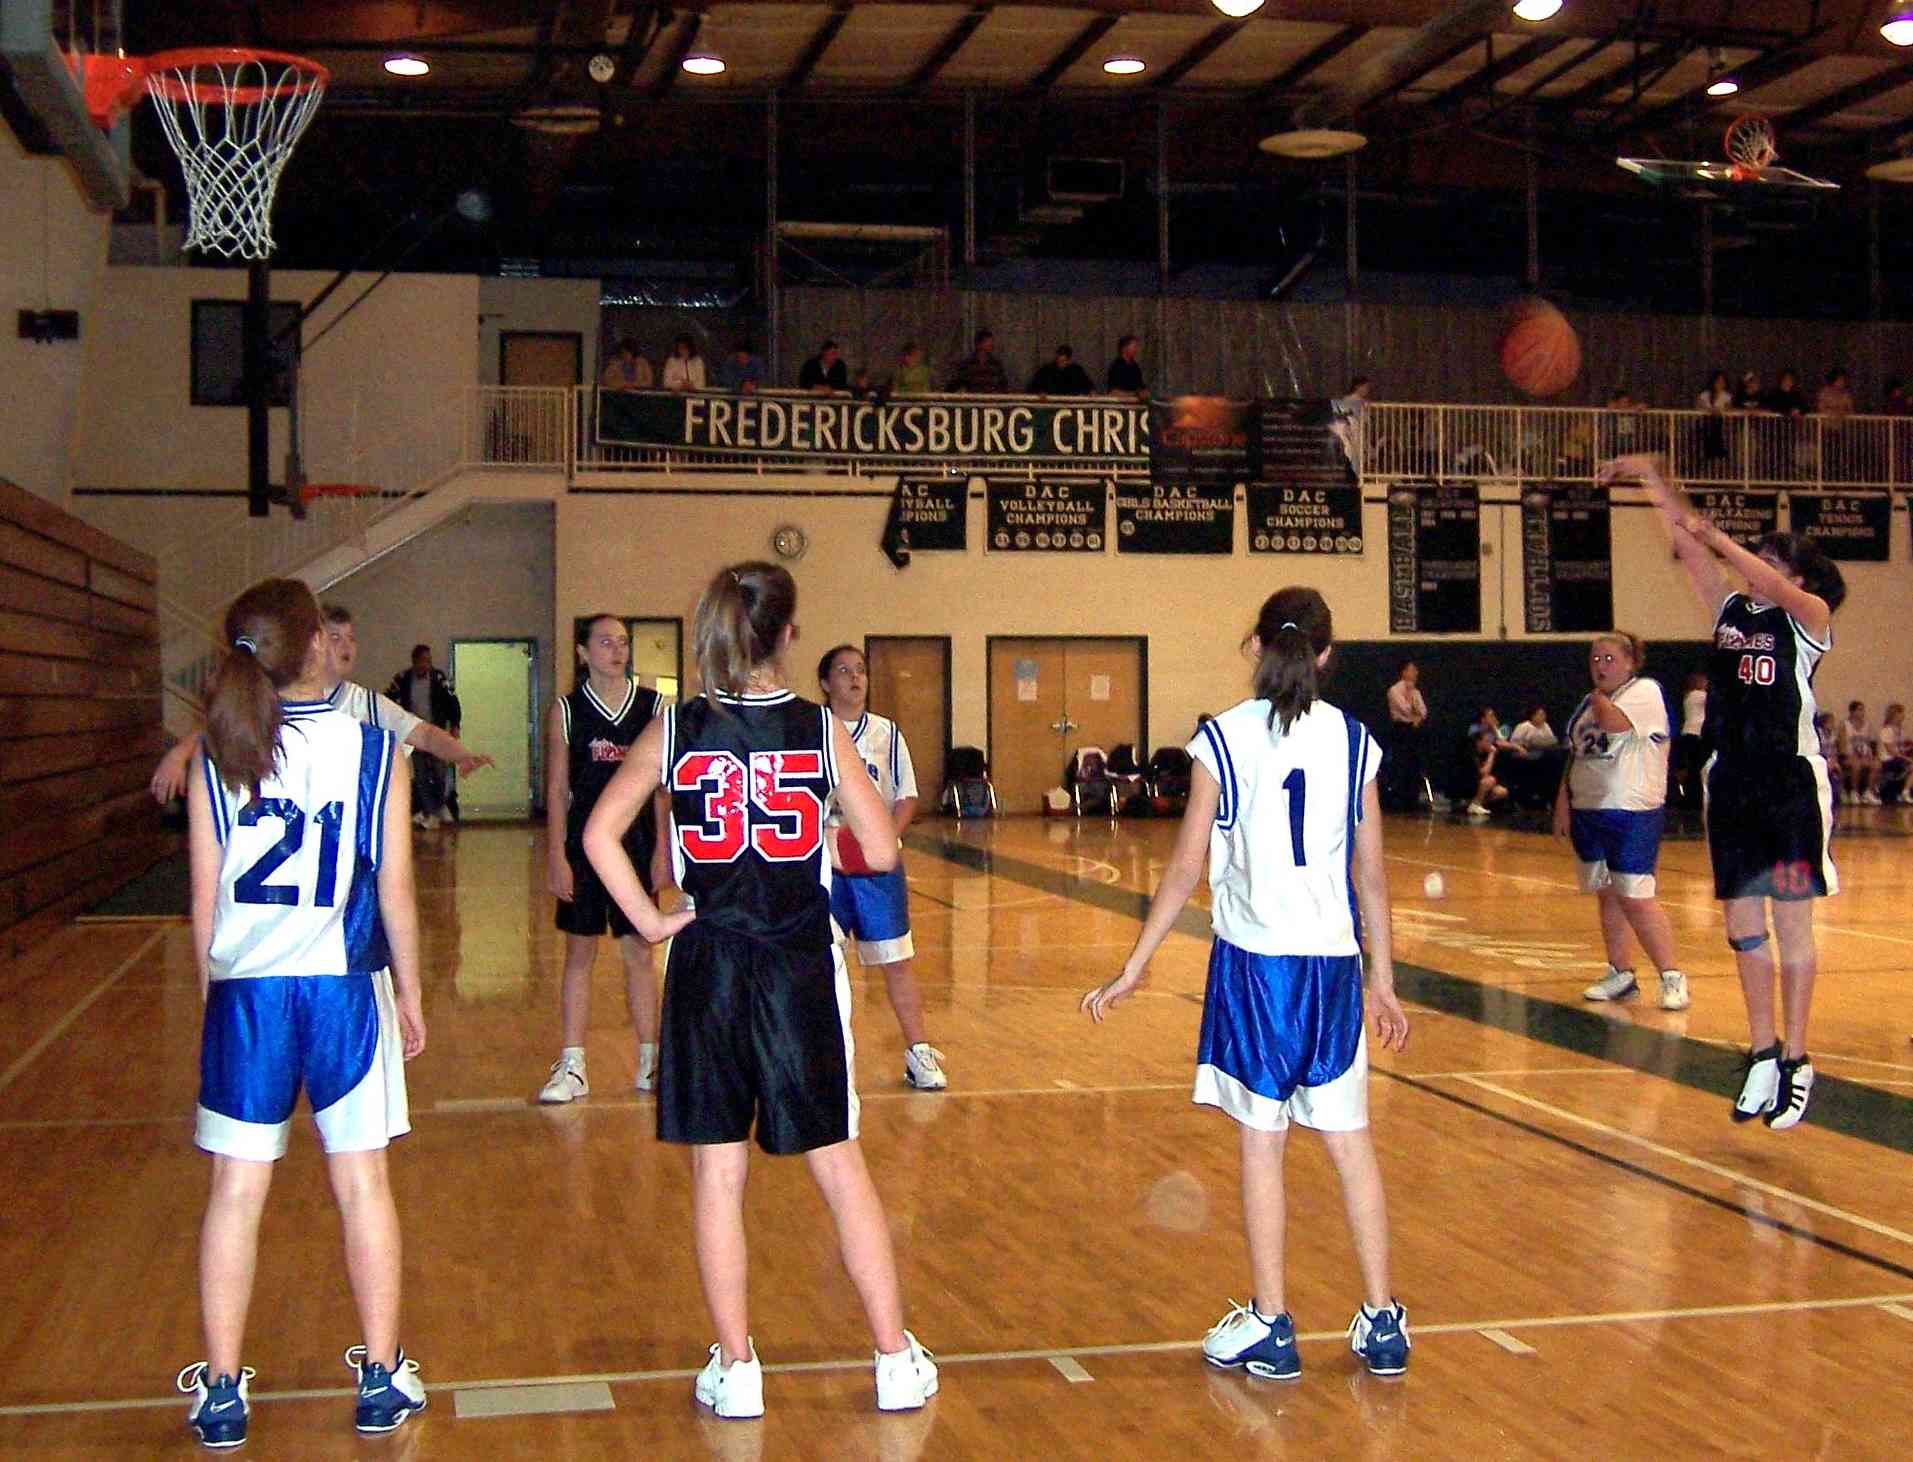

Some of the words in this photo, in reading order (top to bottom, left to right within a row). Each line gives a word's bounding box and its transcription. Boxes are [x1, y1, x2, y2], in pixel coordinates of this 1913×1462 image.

[684, 399, 1034, 452] FREDERICKSBURG
[902, 484, 929, 497] AC
[1000, 499, 1095, 513] VOLLEYBALL
[1152, 498, 1233, 511] BASKETBALL
[1279, 503, 1330, 516] SOCCER
[1006, 512, 1088, 525] CHAMPIONS
[1135, 510, 1215, 522] CHAMPIONS
[1266, 515, 1345, 529] CHAMPIONS
[1737, 654, 1777, 686] 40
[672, 750, 823, 864] 35
[1281, 767, 1307, 867] 1
[233, 796, 345, 908] 21
